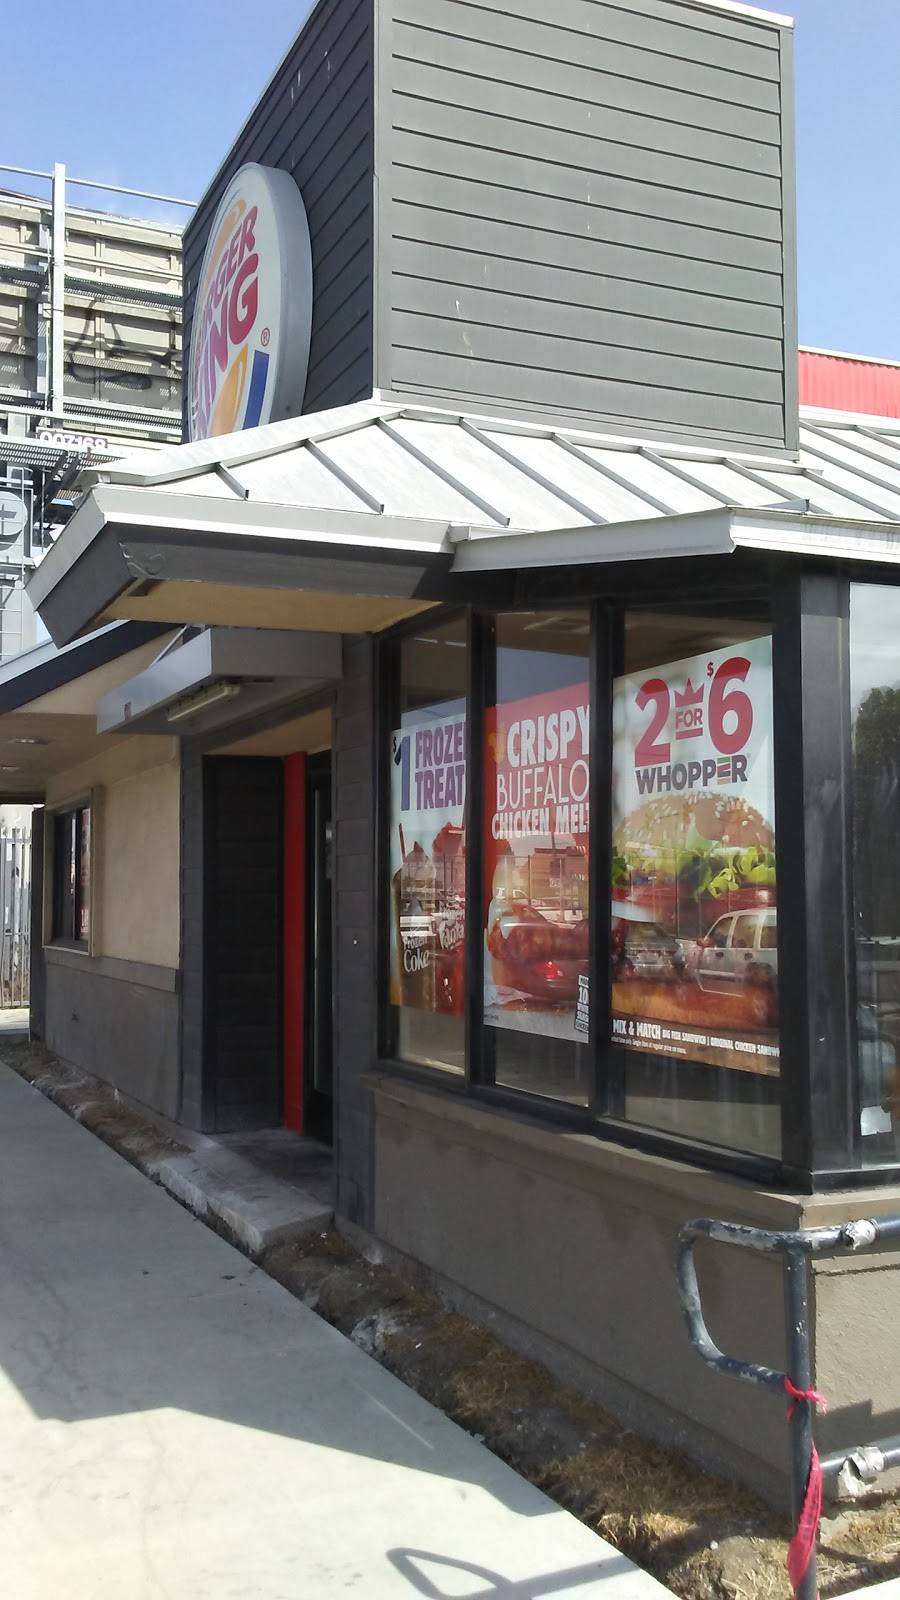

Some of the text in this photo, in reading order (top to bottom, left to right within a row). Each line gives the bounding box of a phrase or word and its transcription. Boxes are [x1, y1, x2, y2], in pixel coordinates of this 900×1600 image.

[507, 704, 590, 767] CRISPY
[634, 678, 671, 768] 2
[675, 708, 703, 729] FOR
[415, 722, 466, 769] FROZE
[496, 759, 590, 810] BUFFALO
[635, 754, 748, 795] WHOPPER
[491, 807, 550, 840] CHICKEN
[404, 948, 429, 973] Coke
[612, 1019, 626, 1034] MIX
[628, 1021, 634, 1036] &
[636, 1022, 661, 1040] MATCH
